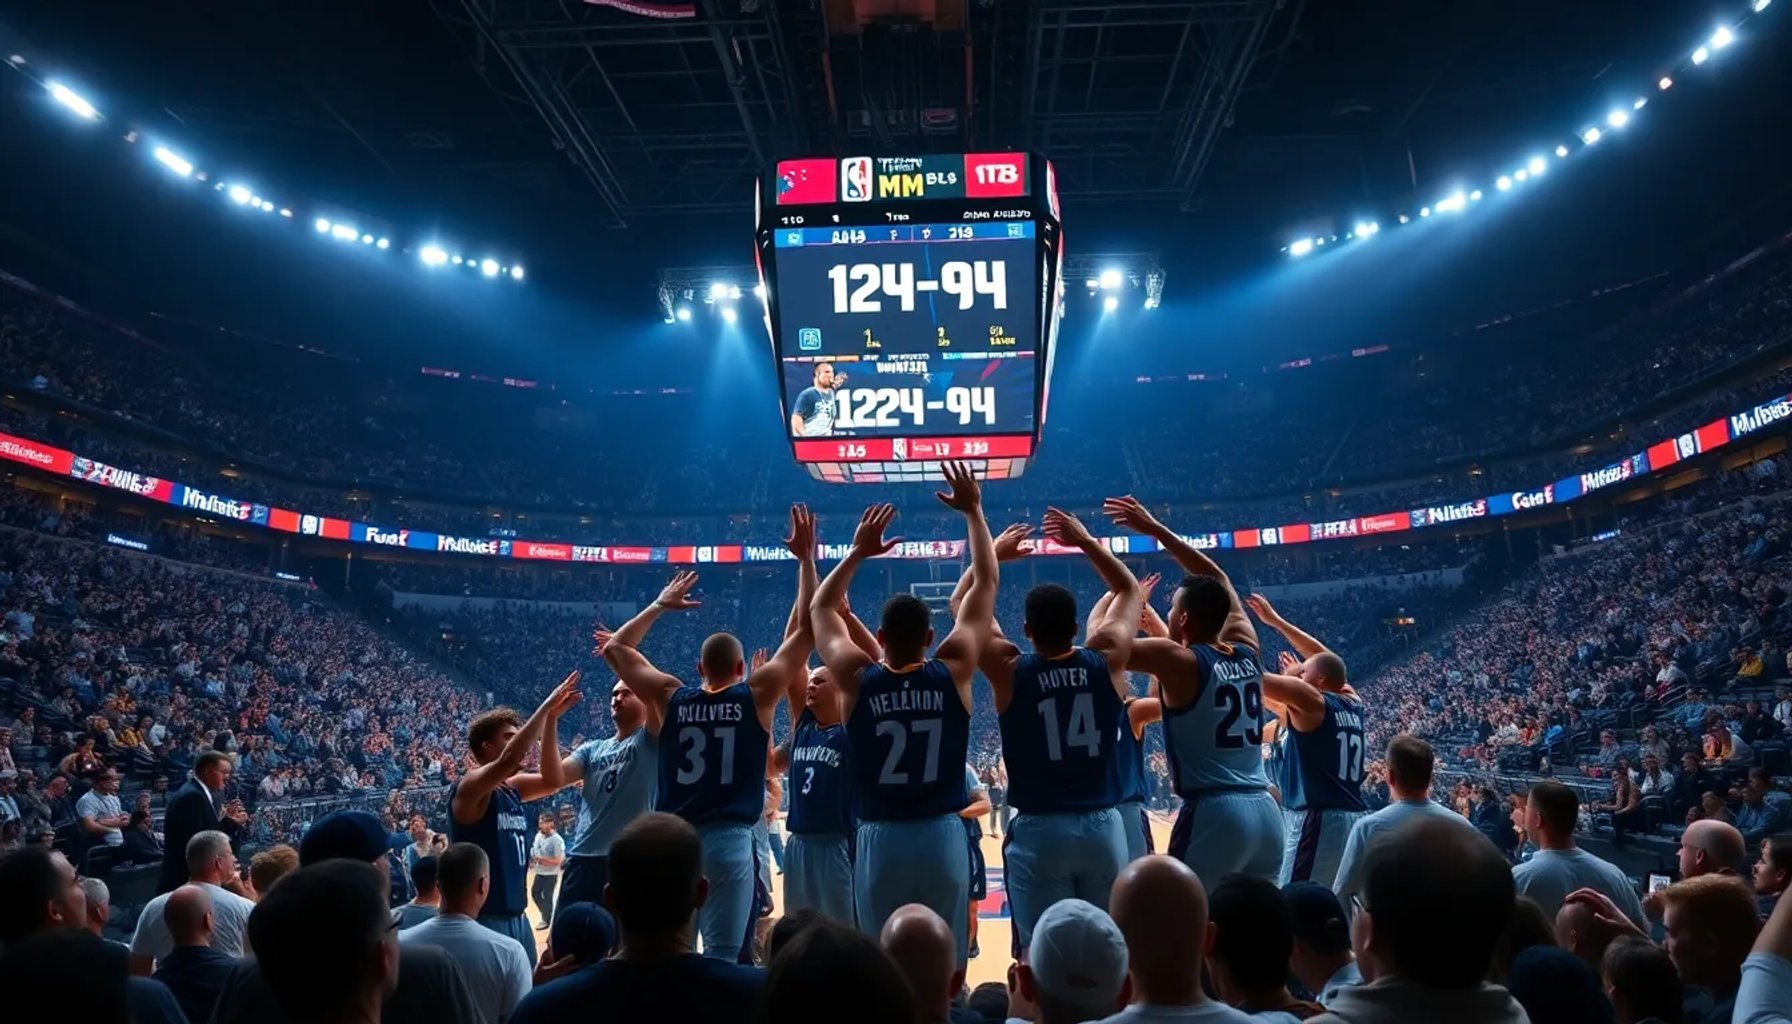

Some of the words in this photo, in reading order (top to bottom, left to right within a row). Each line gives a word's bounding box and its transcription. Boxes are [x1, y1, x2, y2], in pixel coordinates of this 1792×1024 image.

[878, 173, 924, 198] MM
[828, 260, 1007, 313] 124-94
[834, 386, 996, 429] 1224-94
[1037, 693, 1101, 761] 14
[1214, 682, 1263, 749] 29
[677, 726, 736, 785] 31
[875, 718, 943, 784] 27
[801, 766, 815, 795] 3
